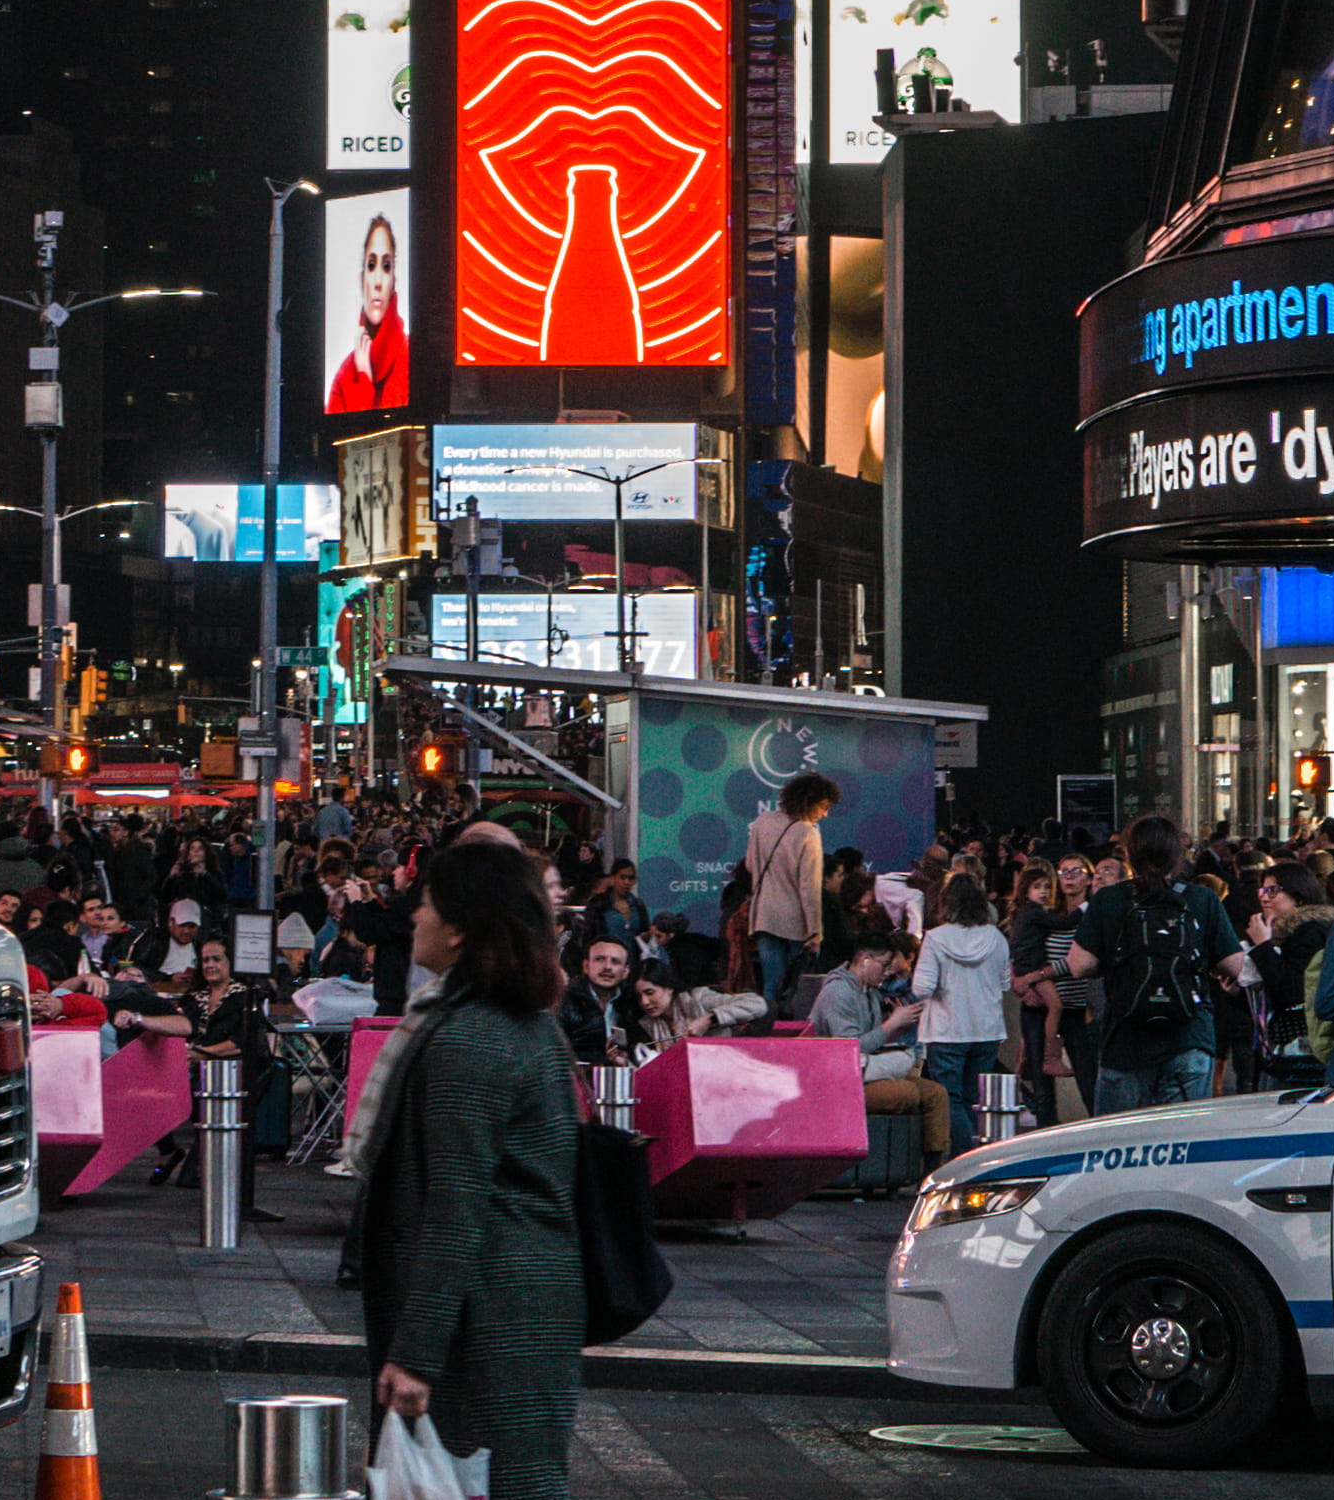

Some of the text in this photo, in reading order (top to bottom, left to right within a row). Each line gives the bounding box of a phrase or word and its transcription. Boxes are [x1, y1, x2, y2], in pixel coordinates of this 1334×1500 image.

[341, 137, 404, 153] RICED
[442, 445, 684, 461] Every time a new Hyundai is purchased,
[1127, 427, 1195, 510] Players
[1199, 427, 1257, 488] are
[507, 480, 604, 492] cancer is made.
[491, 602, 534, 614] Hyundai
[281, 647, 312, 663] W 44
[669, 880, 709, 892] GIFTS
[1081, 1141, 1188, 1175] POLICE
